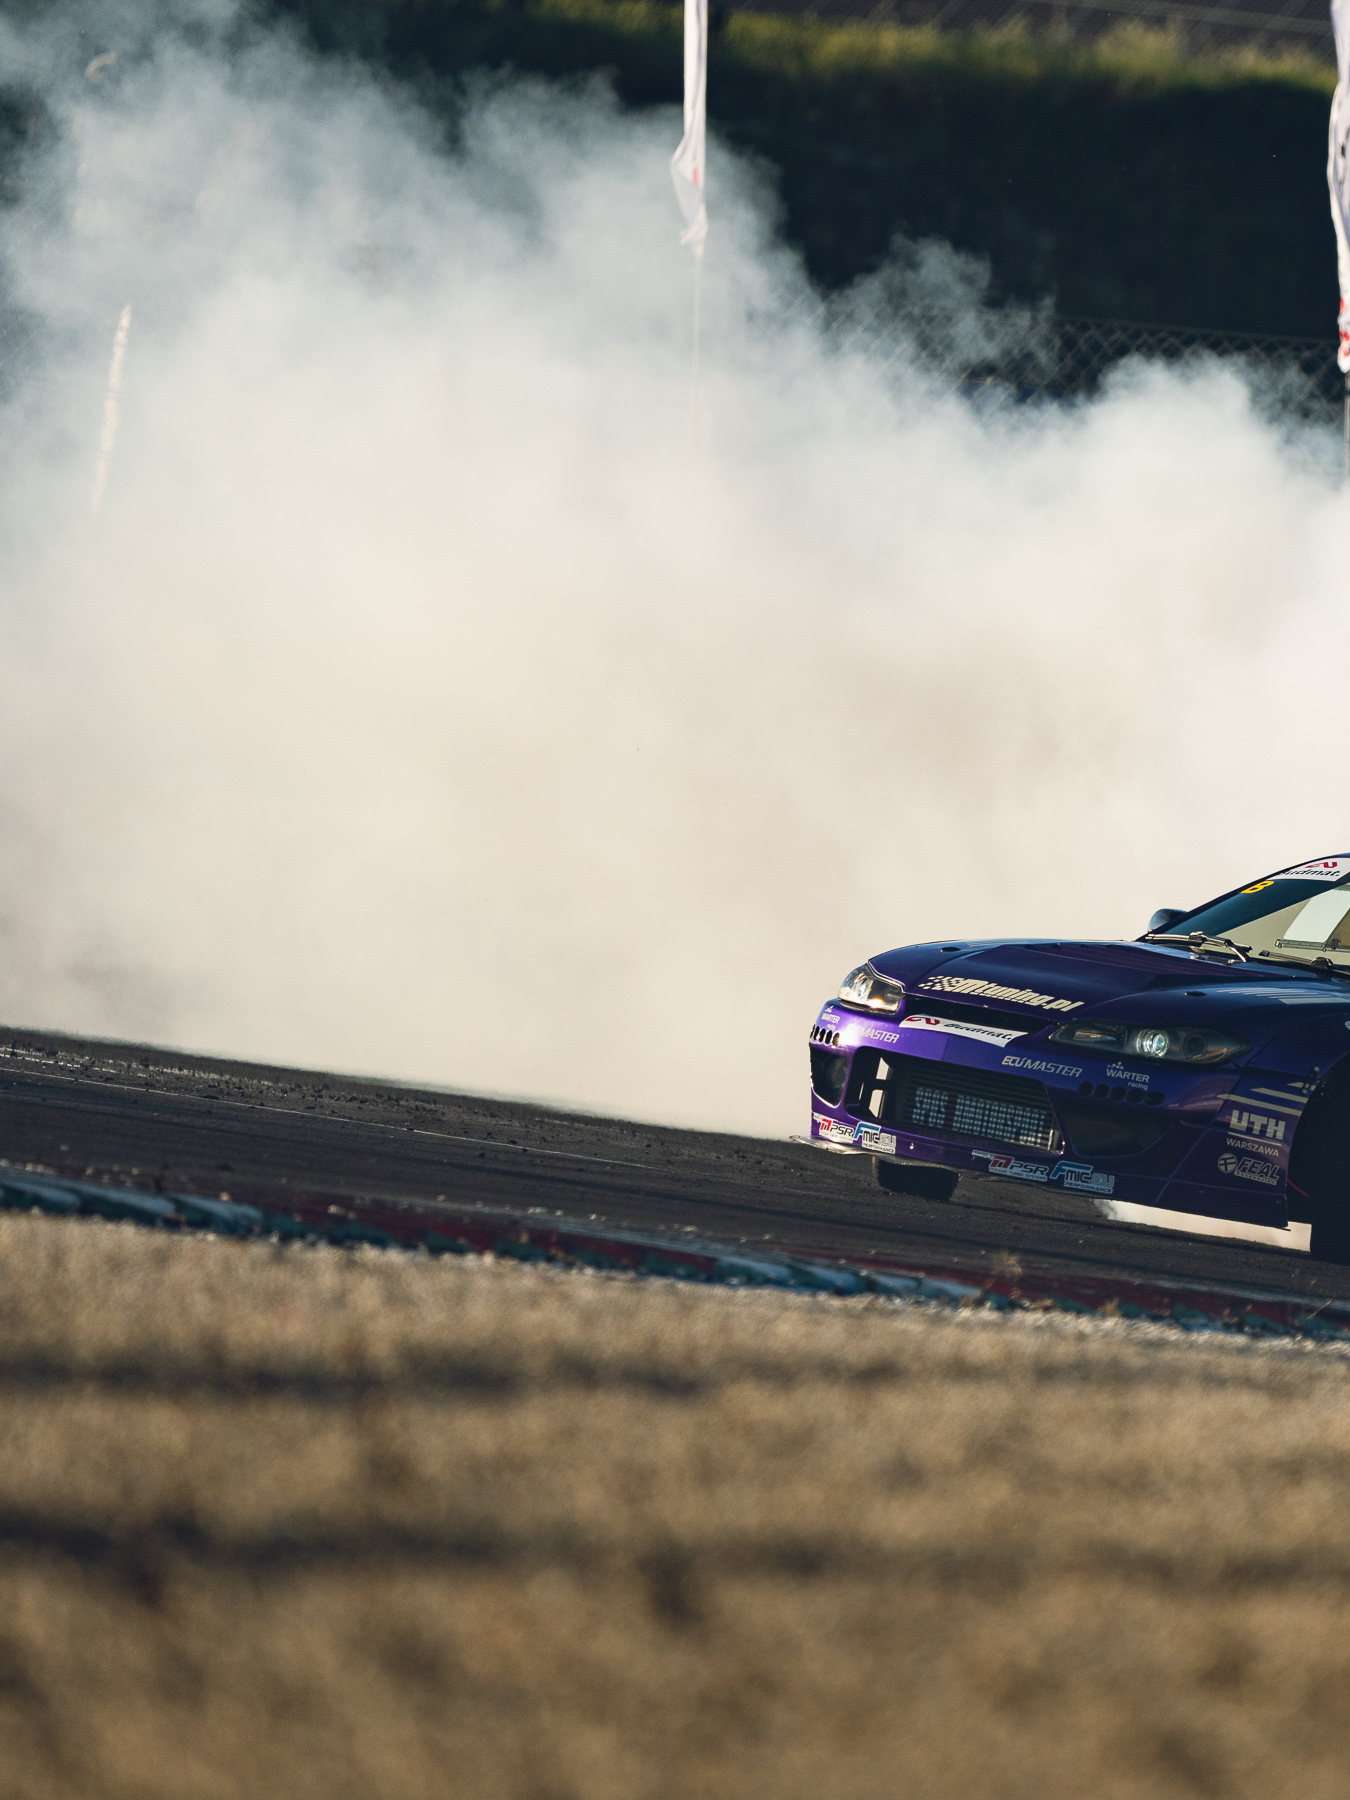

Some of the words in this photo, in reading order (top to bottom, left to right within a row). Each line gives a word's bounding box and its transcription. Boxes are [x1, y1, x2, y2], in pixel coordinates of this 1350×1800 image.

[851, 1024, 900, 1044] MASTER
[1106, 1068, 1150, 1084] WARTER
[1127, 1081, 1149, 1091] racing
[1229, 1109, 1286, 1141] UTH
[1226, 1137, 1280, 1157] WARSZAWA
[1236, 1157, 1280, 1180] FEAL
[1064, 1181, 1113, 1193] PERFORMANCE
